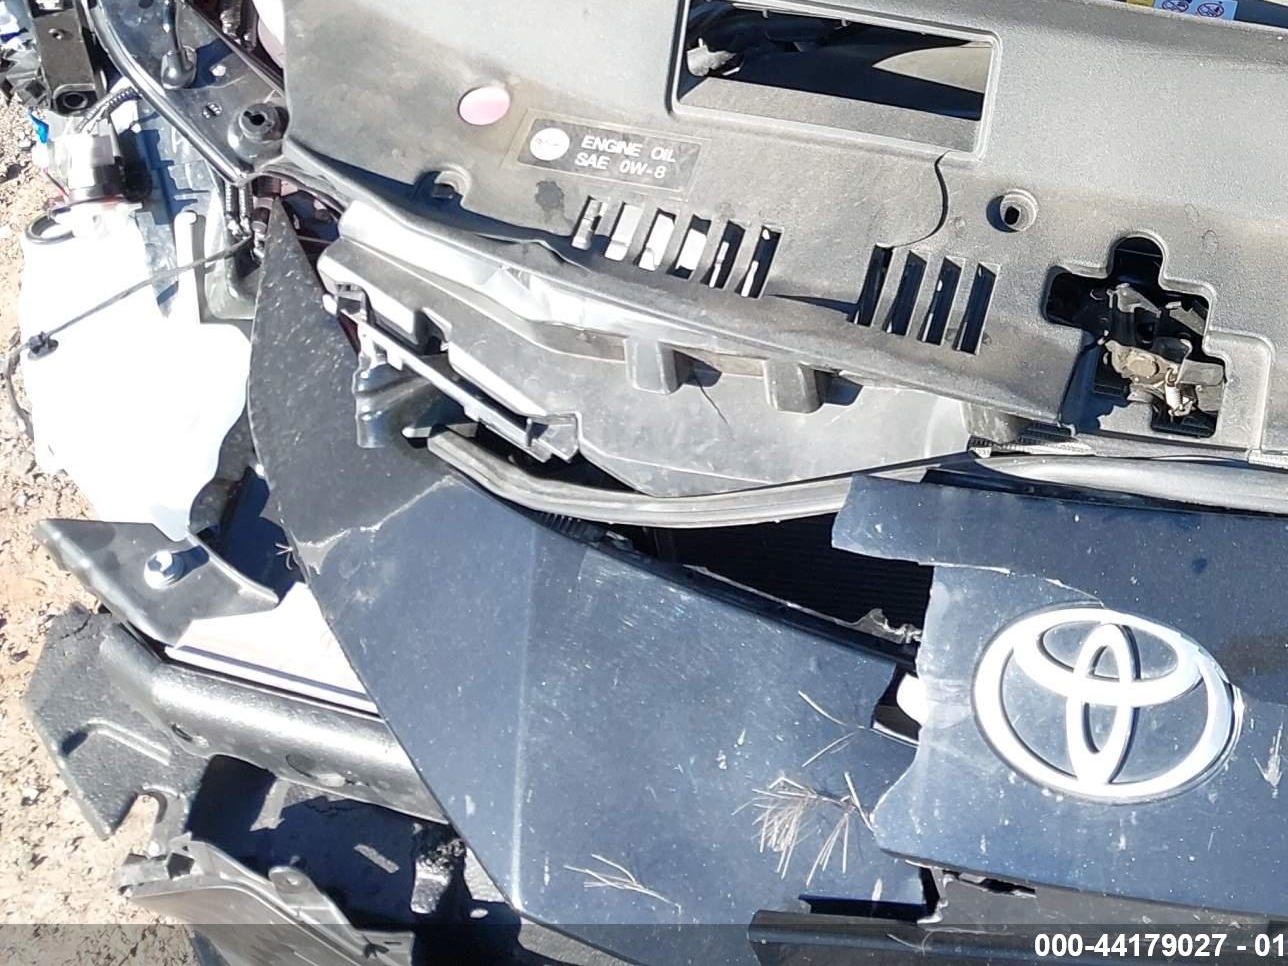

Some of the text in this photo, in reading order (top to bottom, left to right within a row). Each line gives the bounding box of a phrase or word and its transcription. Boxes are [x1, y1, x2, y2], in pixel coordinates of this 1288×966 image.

[580, 134, 677, 163] ENGINE OIL
[574, 152, 667, 179] SAE 0W-8
